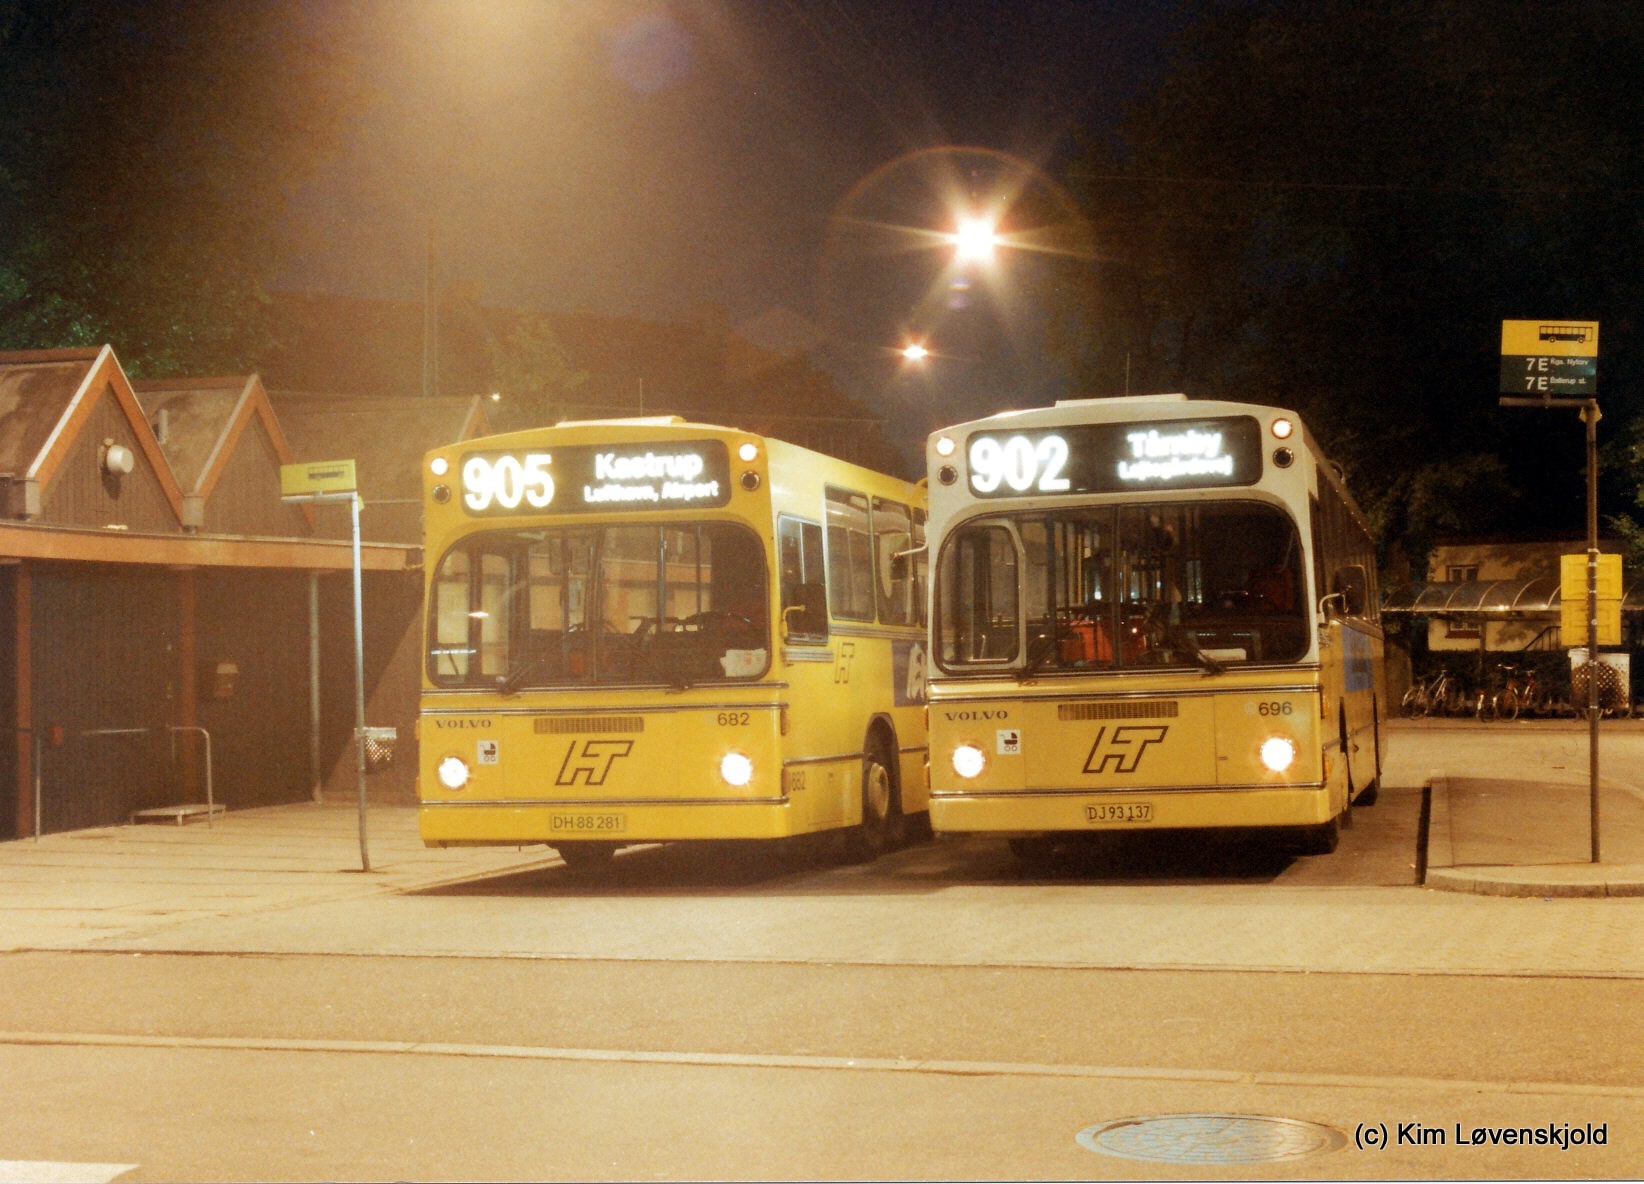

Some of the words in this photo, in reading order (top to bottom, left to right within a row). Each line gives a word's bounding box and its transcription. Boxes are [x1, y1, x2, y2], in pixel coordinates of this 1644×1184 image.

[1525, 357, 1549, 371] 7E
[1525, 376, 1548, 390] 7E
[595, 452, 704, 480] Kastrup
[969, 435, 1070, 492] 902
[463, 454, 555, 510] 905
[945, 710, 1009, 722] VOLVO
[1258, 701, 1293, 716] 696
[436, 719, 492, 729] VOLVO
[717, 712, 750, 727] 682
[1082, 725, 1169, 774] HT
[555, 740, 635, 786] HT
[1087, 807, 1106, 820] DJ
[1108, 806, 1124, 819] 93
[1128, 805, 1150, 820] 137
[553, 816, 574, 830] DH
[597, 815, 620, 829] 281
